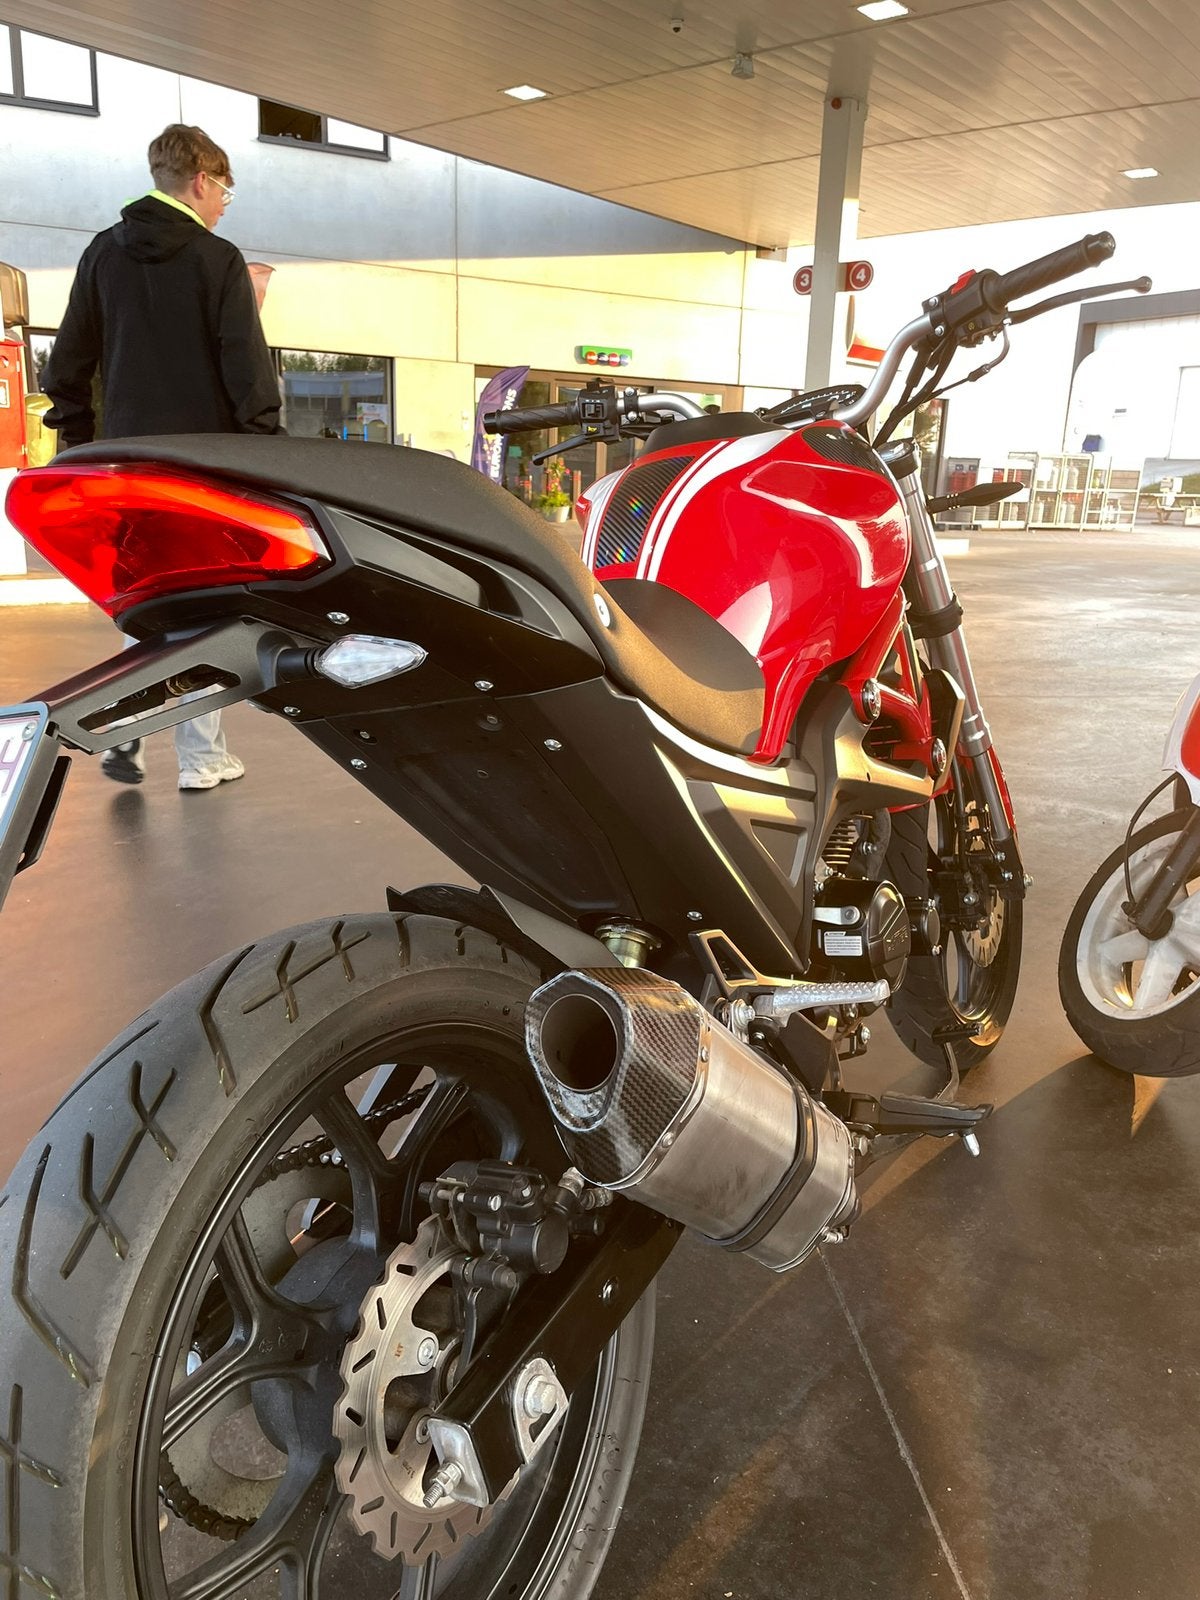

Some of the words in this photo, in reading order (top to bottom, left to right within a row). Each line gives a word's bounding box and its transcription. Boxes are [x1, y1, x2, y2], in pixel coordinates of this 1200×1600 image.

[800, 273, 810, 287] 3
[856, 268, 866, 282] 4
[489, 388, 517, 478] EUROMONS
